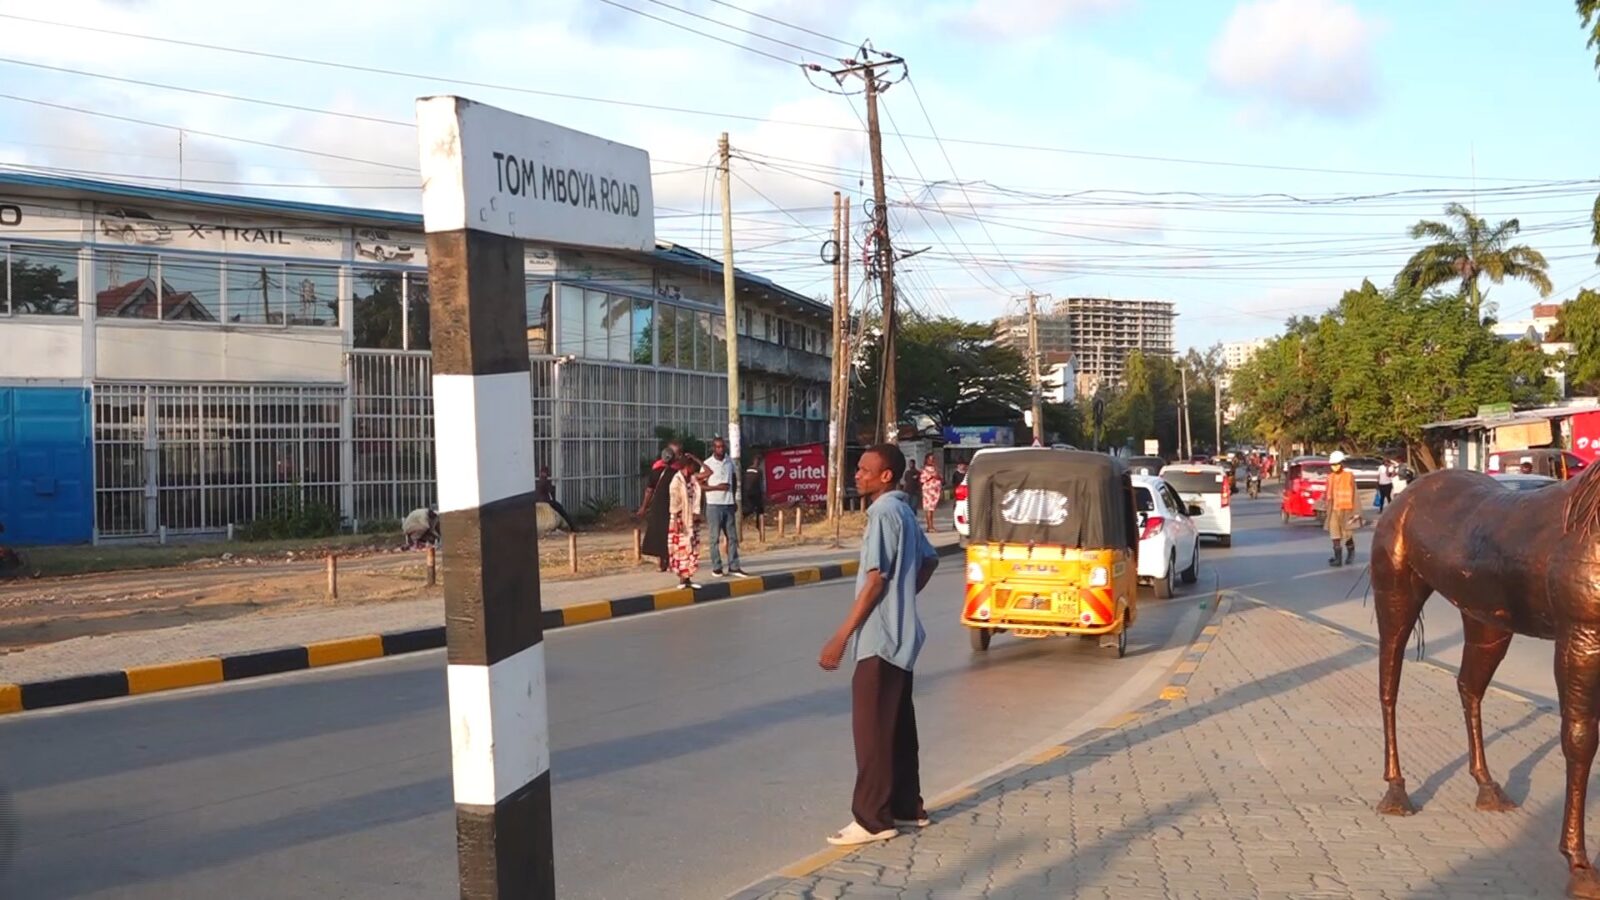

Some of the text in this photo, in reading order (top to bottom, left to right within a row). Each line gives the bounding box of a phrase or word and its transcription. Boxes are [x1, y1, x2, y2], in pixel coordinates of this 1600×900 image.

[494, 152, 639, 216] TOM MBOYA ROAD
[187, 223, 291, 245] X-TRAIL
[789, 465, 826, 480] airtel
[795, 483, 821, 492] money
[1012, 564, 1059, 572] ATUL
